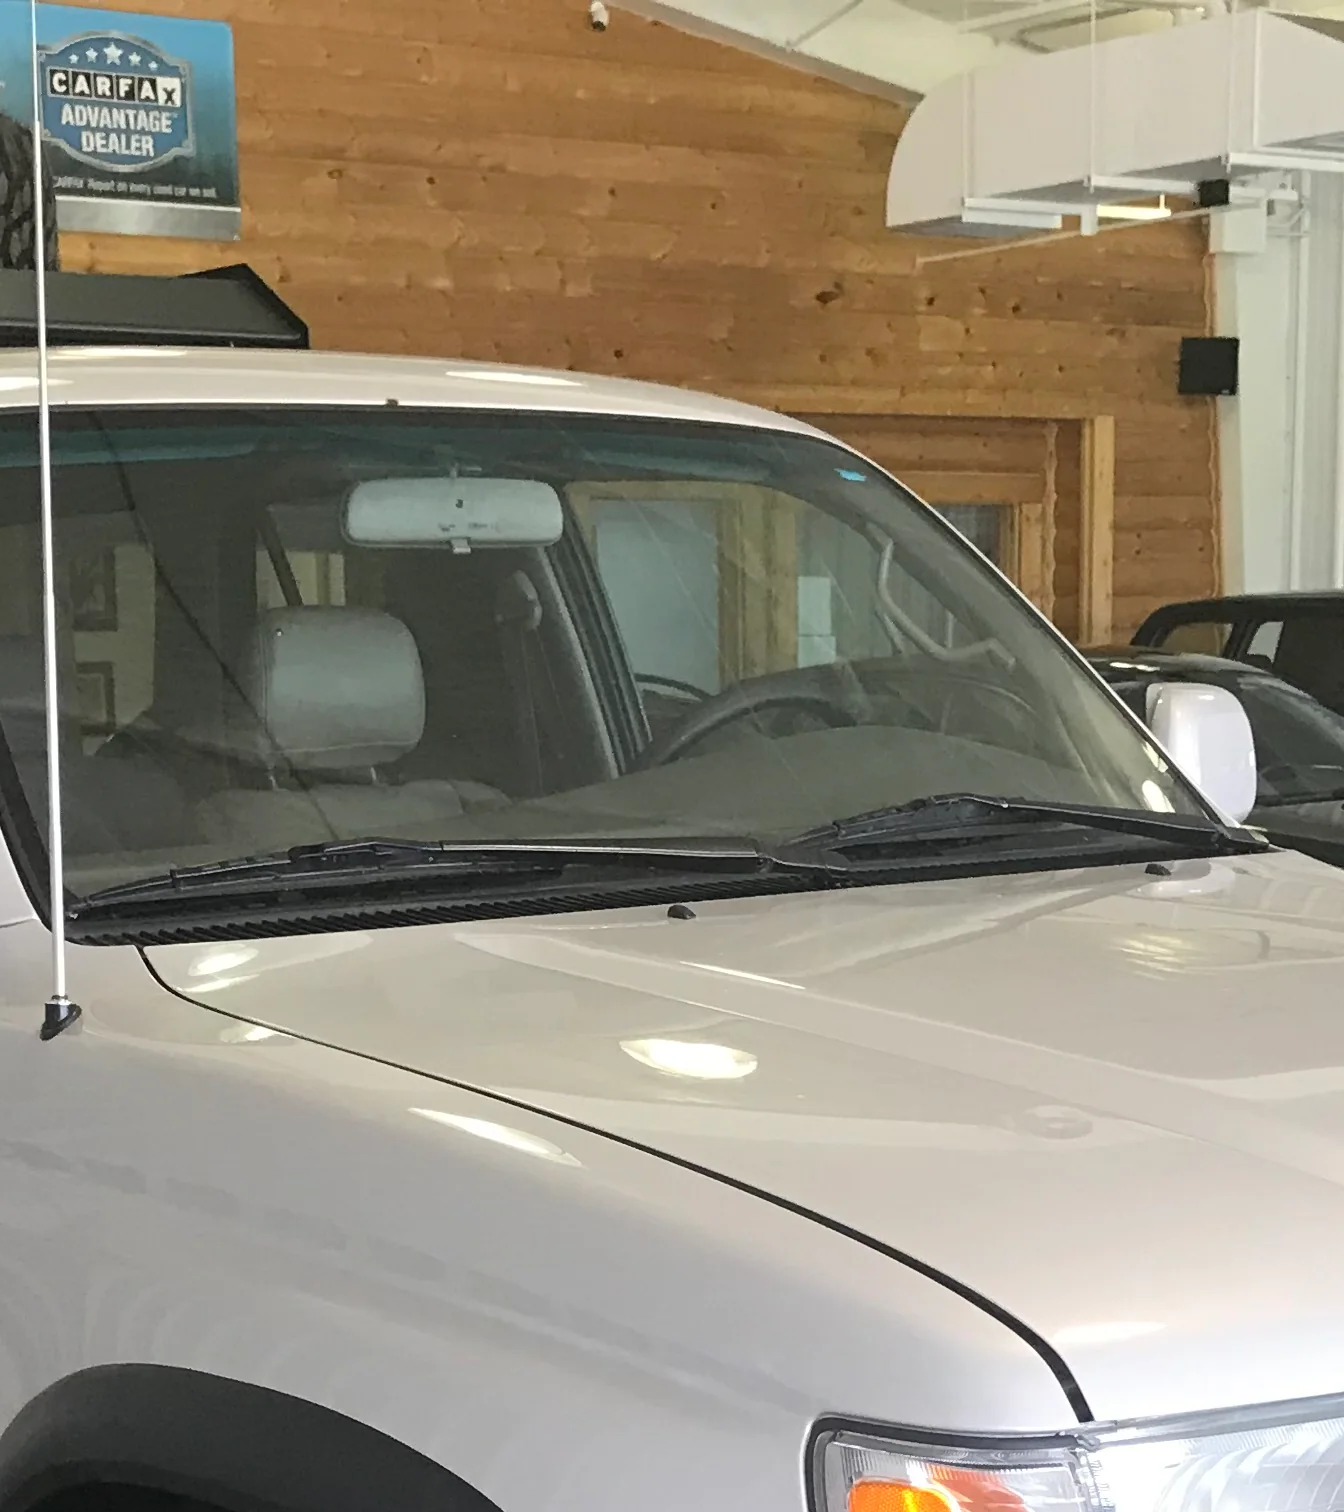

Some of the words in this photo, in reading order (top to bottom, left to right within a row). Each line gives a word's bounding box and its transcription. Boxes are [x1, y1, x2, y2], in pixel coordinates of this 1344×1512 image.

[52, 72, 176, 106] CARFAX
[61, 103, 173, 134] ADVANTAGE
[81, 131, 154, 157] DEALER
